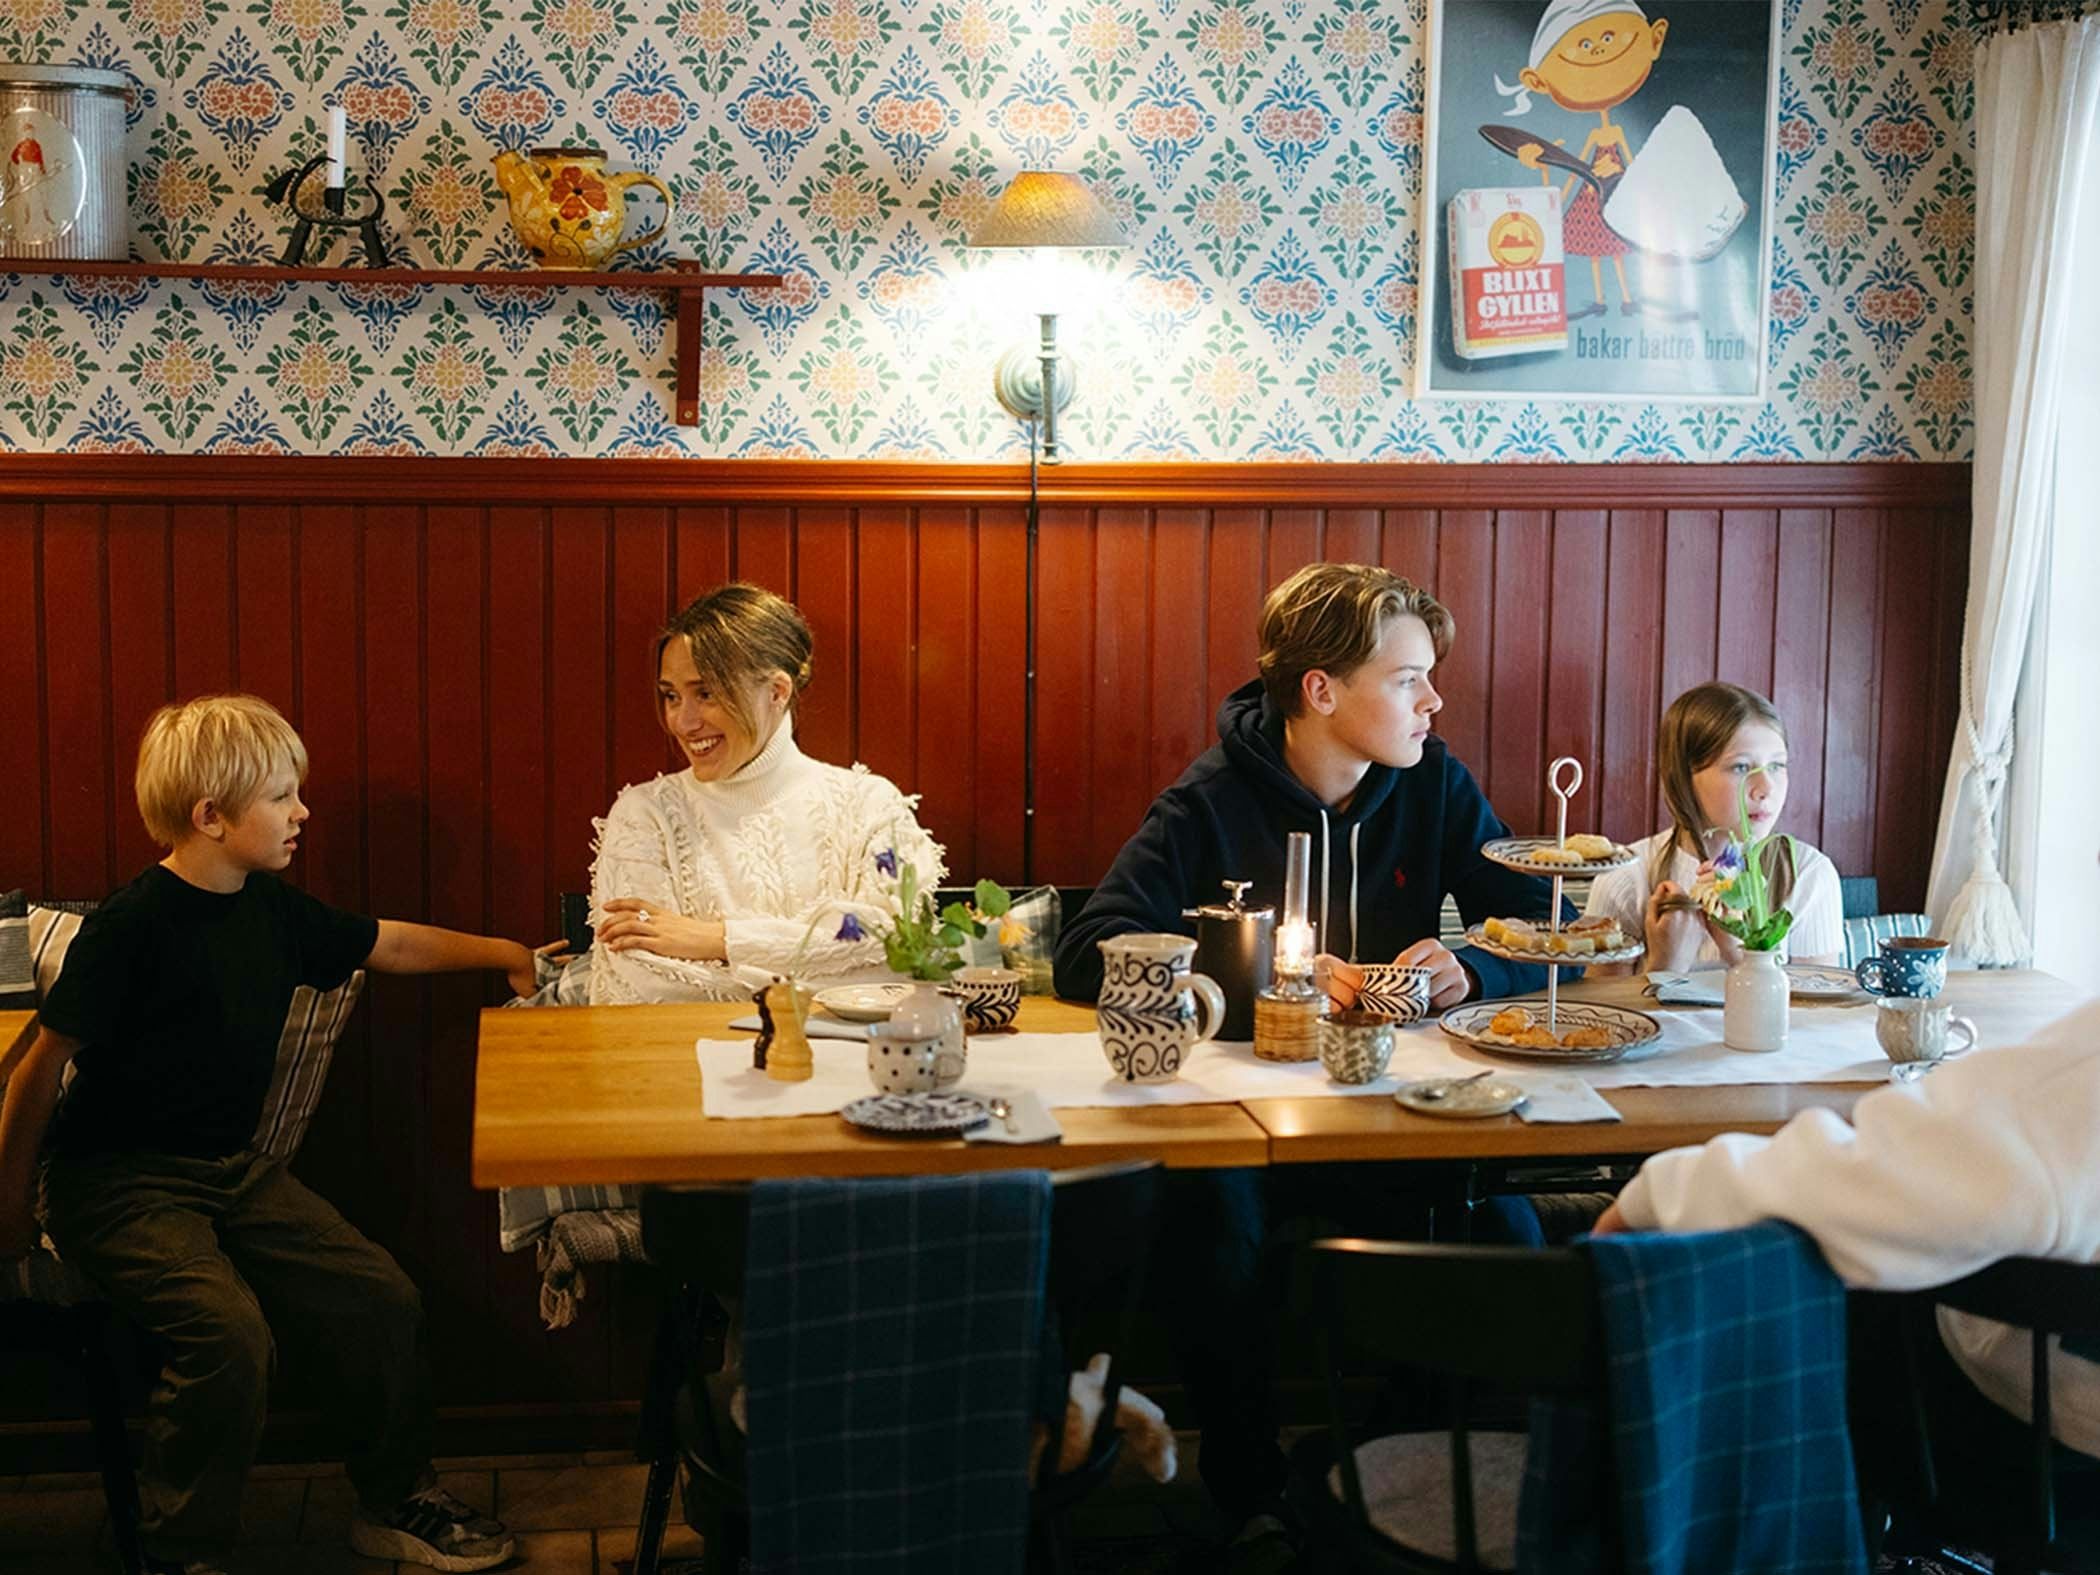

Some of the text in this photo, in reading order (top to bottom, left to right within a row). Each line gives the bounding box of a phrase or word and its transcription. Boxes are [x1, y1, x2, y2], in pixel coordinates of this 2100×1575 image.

[1483, 269, 1551, 293] BLIXT
[1477, 292, 1559, 318] GYLLEN
[1577, 328, 1632, 358] bakar
